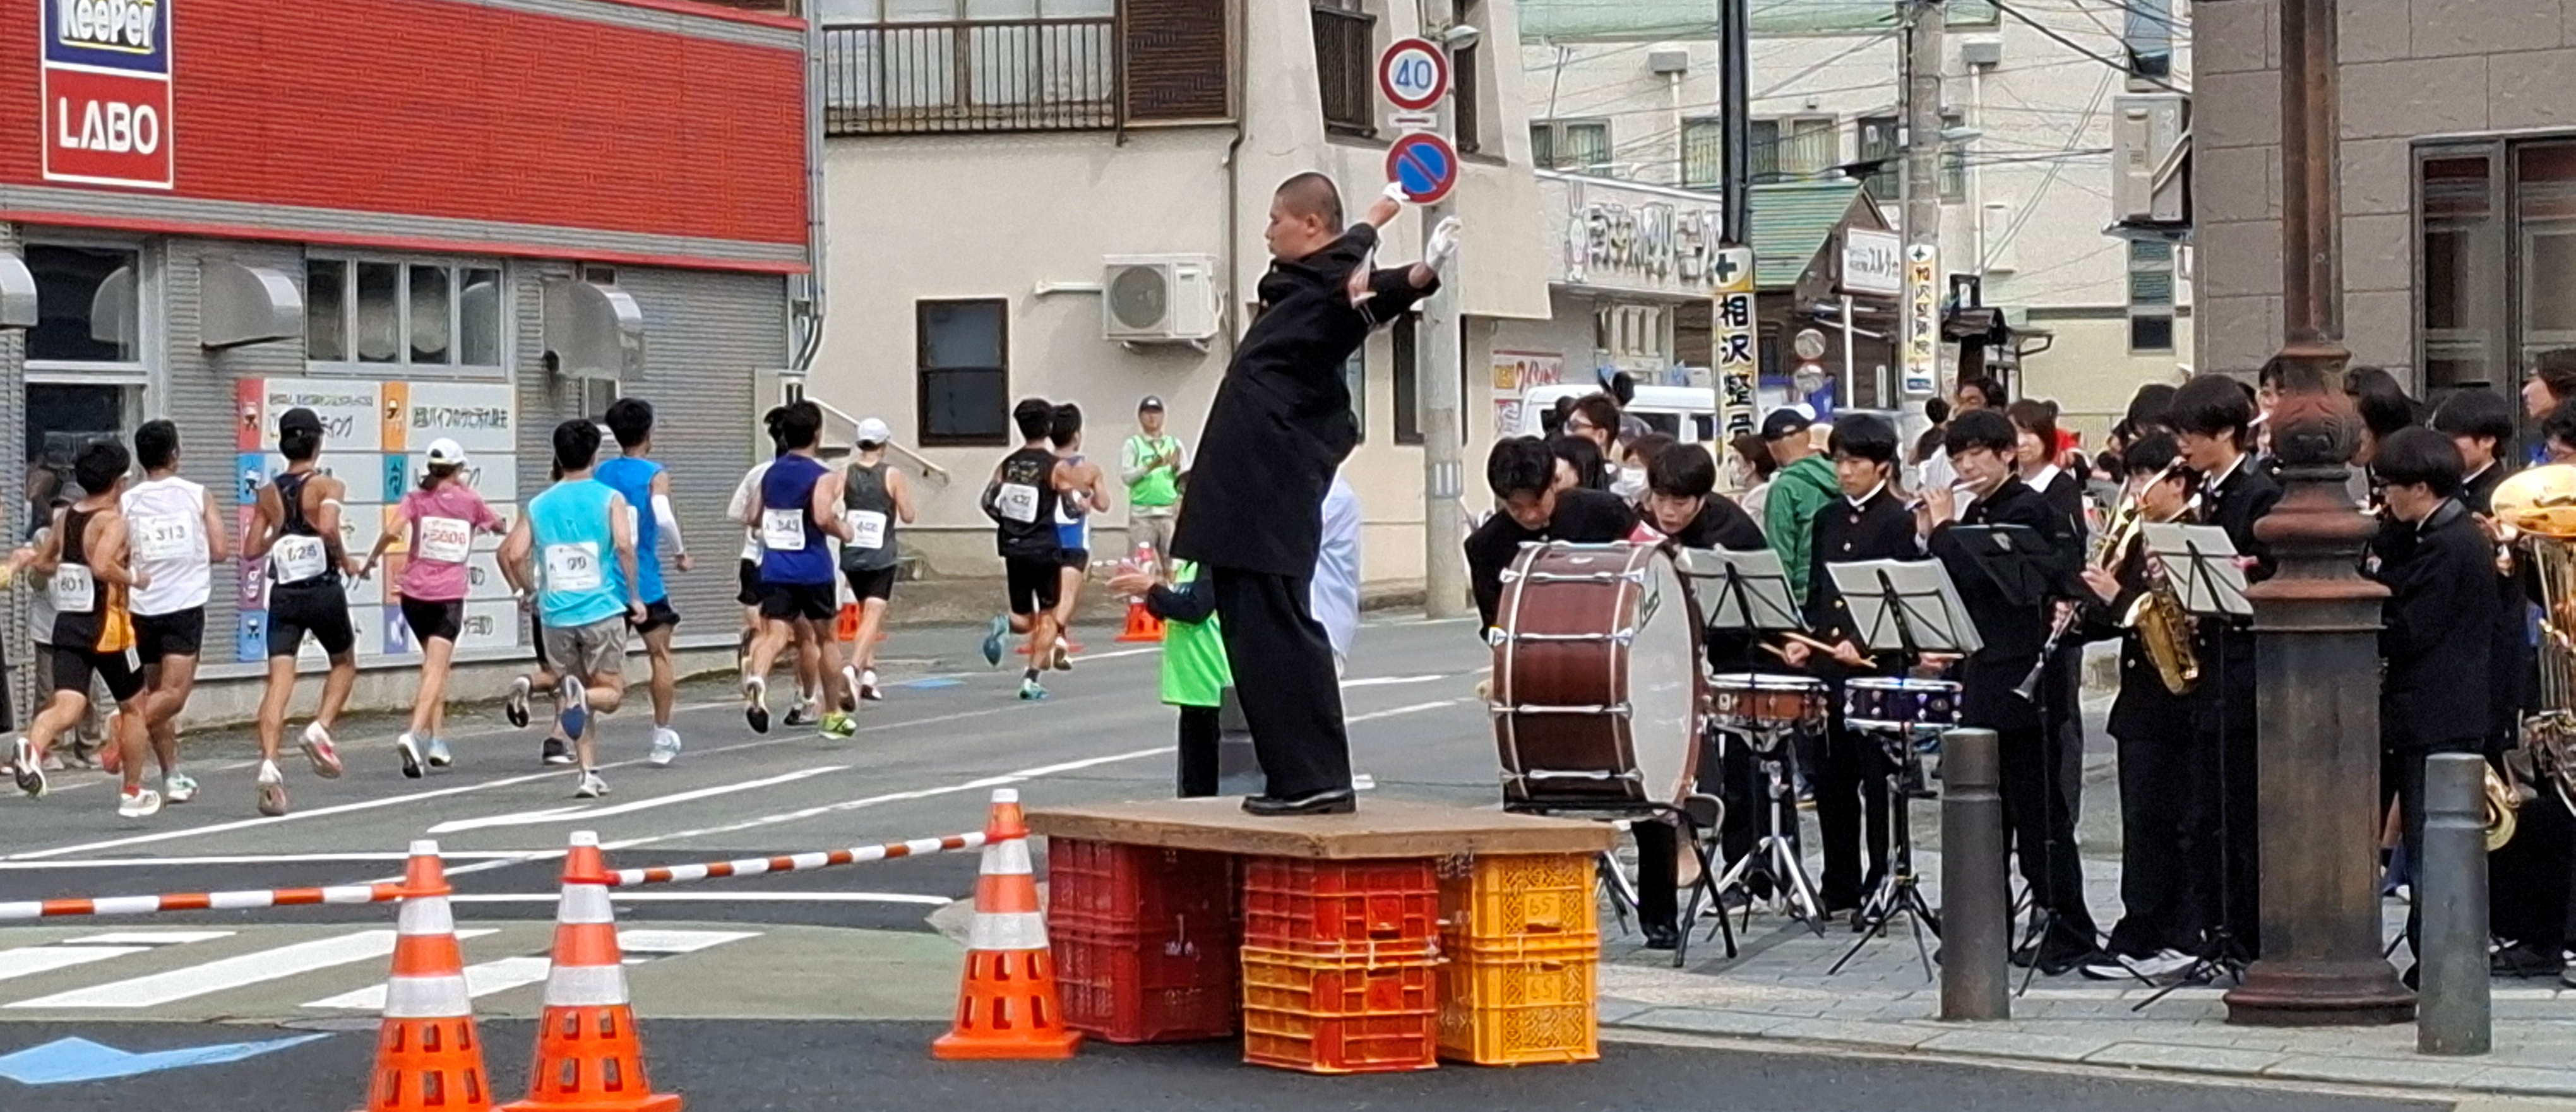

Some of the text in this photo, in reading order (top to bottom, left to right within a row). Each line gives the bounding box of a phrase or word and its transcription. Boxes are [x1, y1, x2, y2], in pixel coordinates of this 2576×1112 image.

[1395, 59, 1433, 90] 40
[59, 97, 158, 155] LABO
[1719, 293, 1755, 488] 相沢整骨
